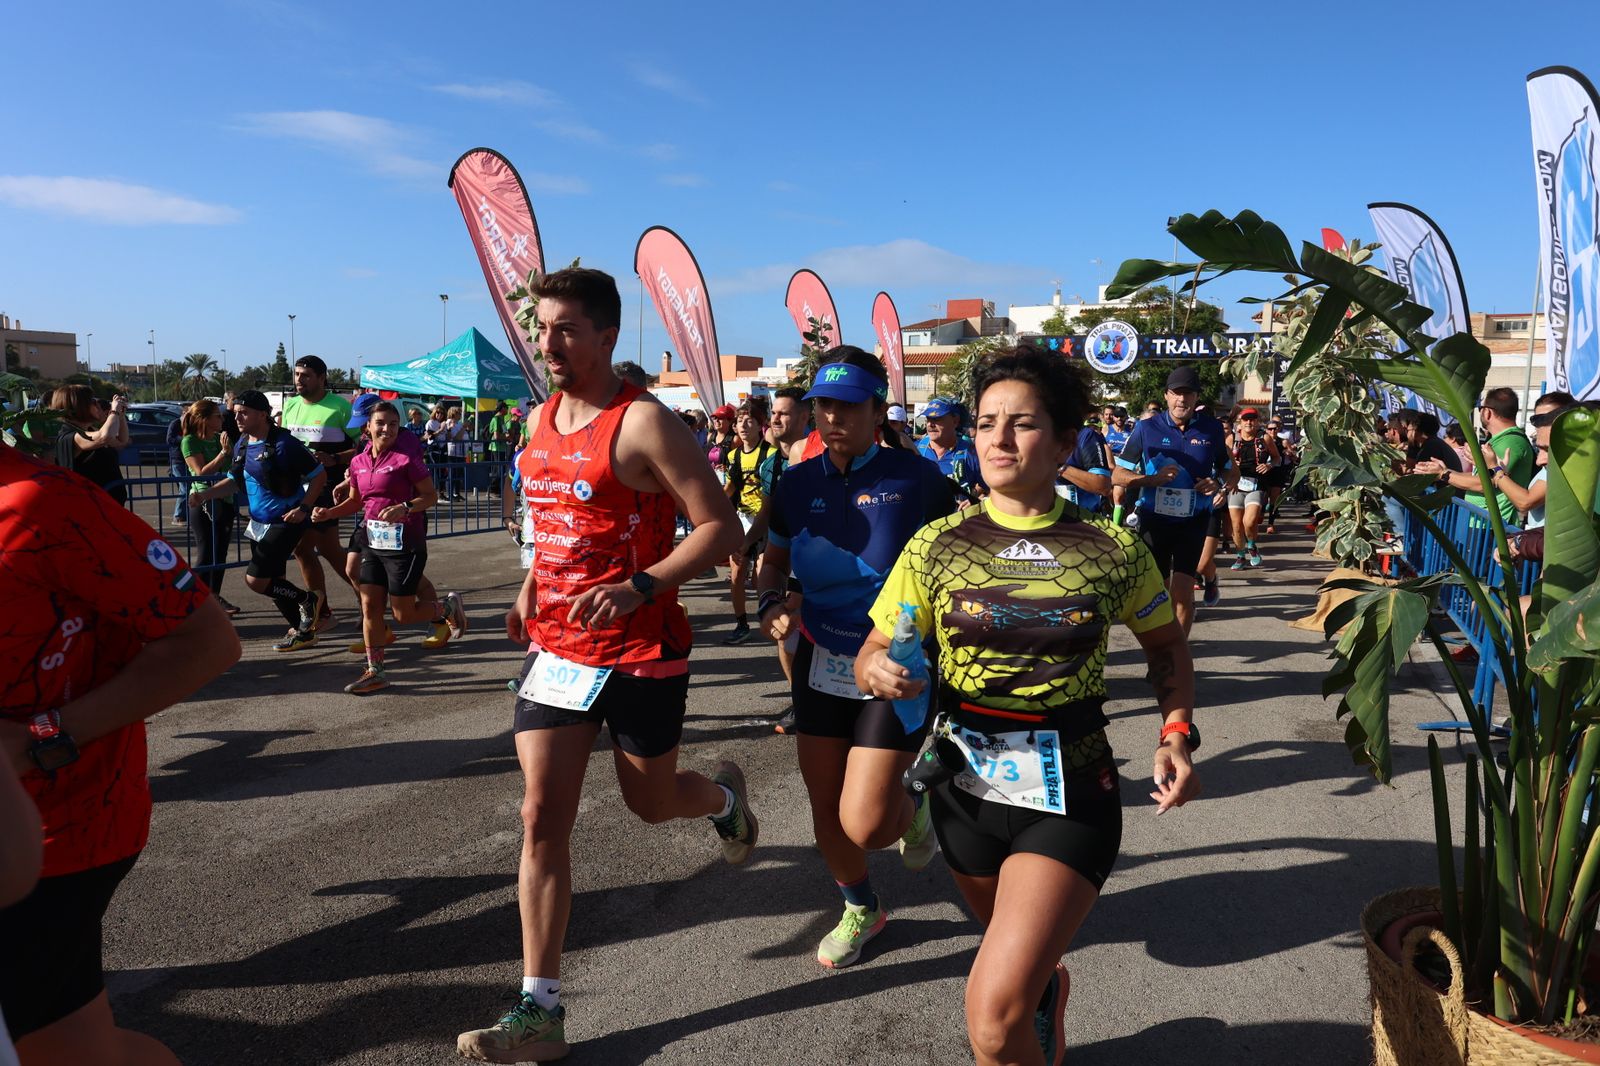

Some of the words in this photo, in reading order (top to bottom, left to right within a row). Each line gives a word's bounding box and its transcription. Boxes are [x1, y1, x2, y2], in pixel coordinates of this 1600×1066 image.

[1152, 339, 1210, 354] TRAIL
[523, 476, 571, 494] Movijerez
[1162, 497, 1182, 508] 536
[547, 534, 592, 548] FITNESS
[1032, 560, 1062, 568] TRAIL
[821, 623, 862, 639] SALOMON
[544, 665, 582, 688] 507
[1047, 738, 1061, 807] PIRATILLA
